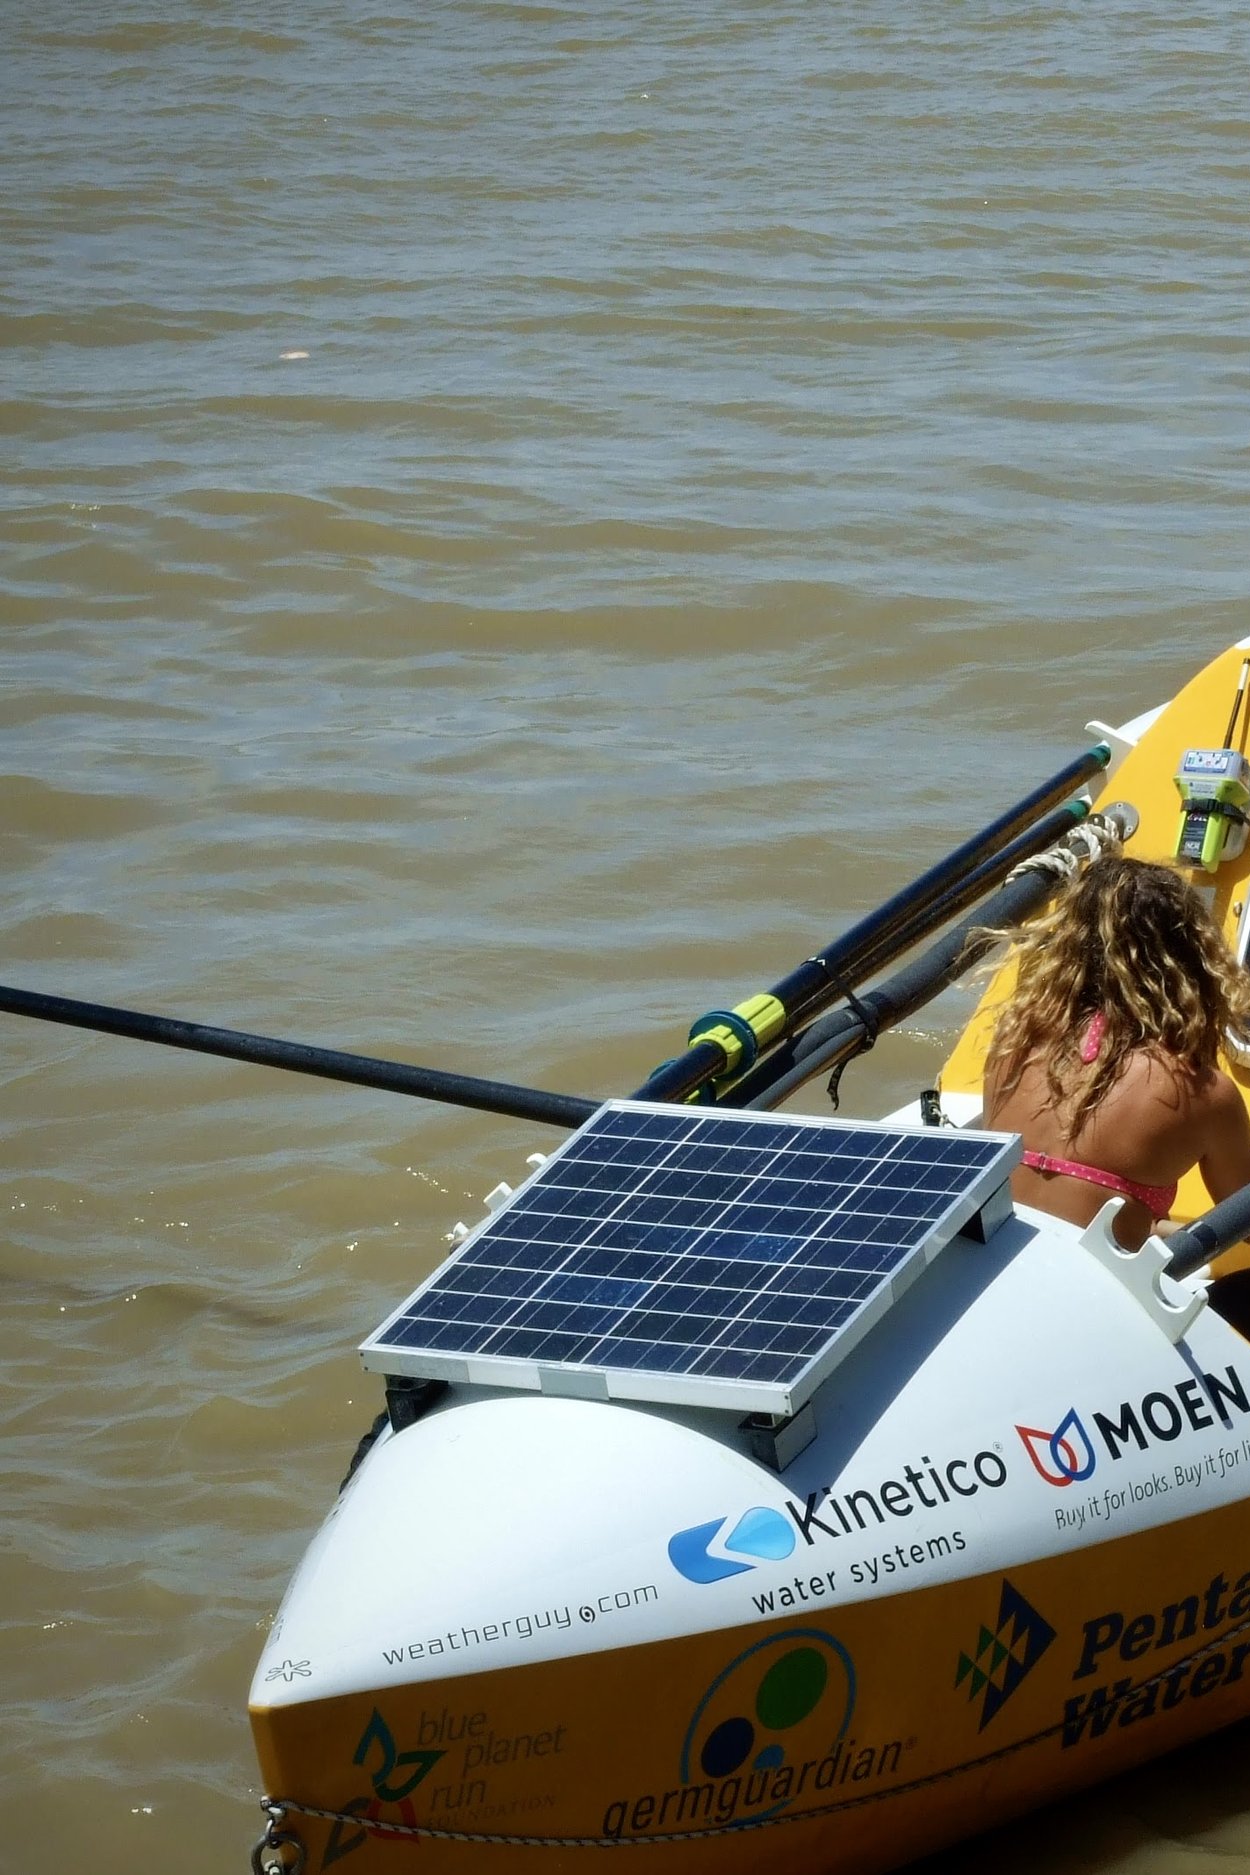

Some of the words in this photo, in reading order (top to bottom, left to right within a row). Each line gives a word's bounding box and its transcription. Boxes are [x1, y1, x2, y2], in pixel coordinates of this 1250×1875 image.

[1092, 1365, 1250, 1460] MOEN
[1055, 1508, 1086, 1530] Buy
[1088, 1497, 1101, 1520] it
[1103, 1489, 1126, 1520] for
[1128, 1473, 1173, 1503] looks.
[1174, 1461, 1202, 1487] Buy
[1203, 1454, 1217, 1476] it
[1218, 1447, 1240, 1478] for
[751, 1571, 836, 1614] water
[850, 1530, 966, 1583] systems
[416, 1708, 487, 1746] blue
[462, 1724, 568, 1778] planet
[431, 1780, 487, 1812] run
